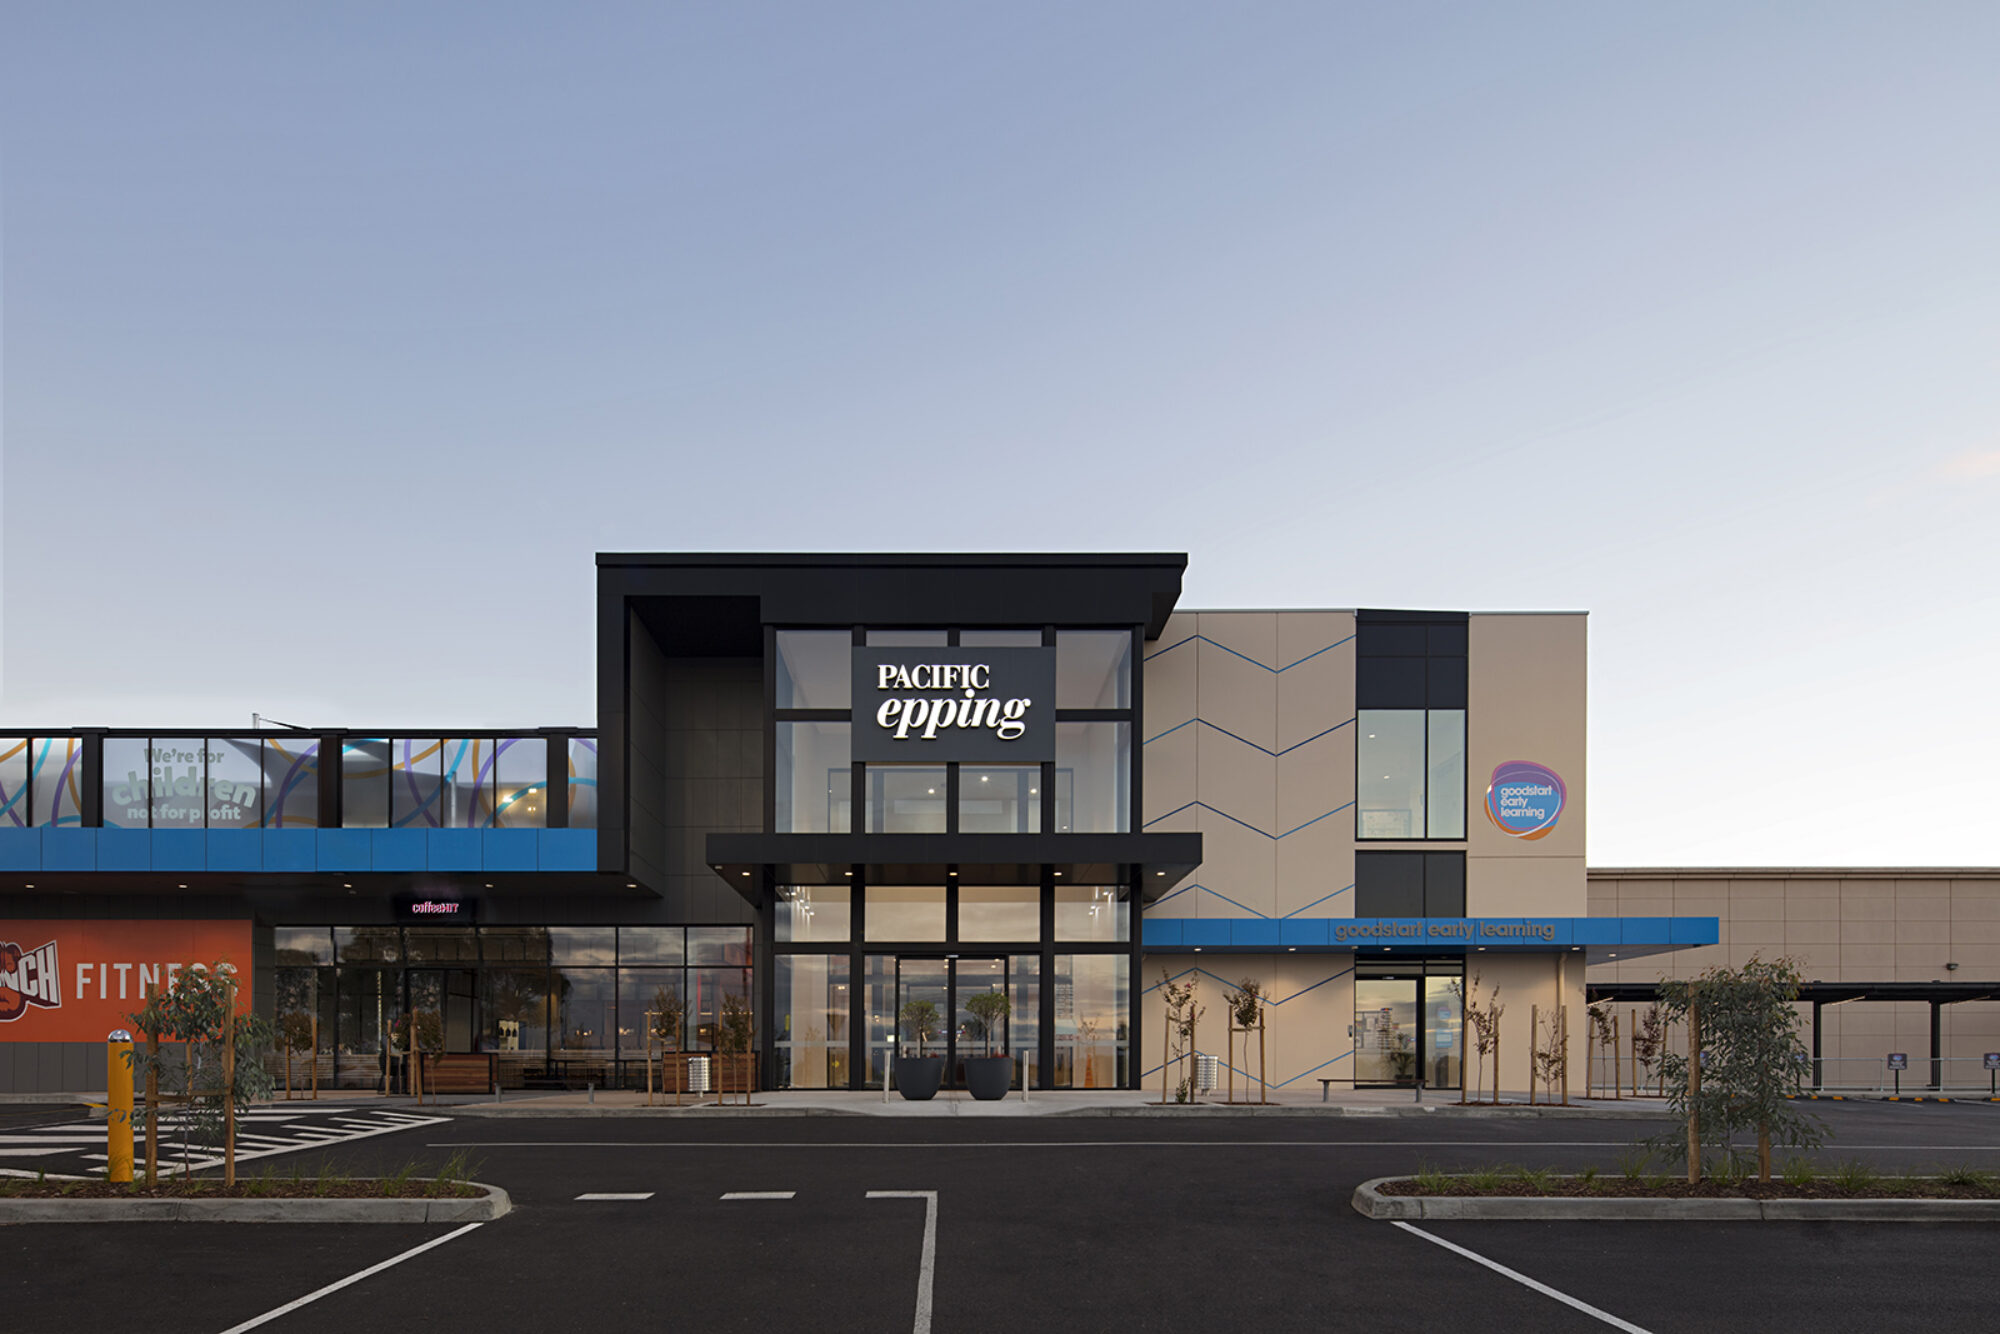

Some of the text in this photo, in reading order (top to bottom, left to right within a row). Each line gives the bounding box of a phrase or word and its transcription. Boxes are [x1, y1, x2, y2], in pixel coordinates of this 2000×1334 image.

[877, 664, 990, 689] PACIFIC
[876, 689, 1032, 740] epping
[144, 748, 224, 763] We're for
[112, 766, 256, 808] children
[1500, 785, 1552, 798] goodstart
[1500, 796, 1528, 808] early
[160, 804, 186, 820] for
[1500, 807, 1545, 819] learning
[1335, 921, 1555, 940] goodstart early learning
